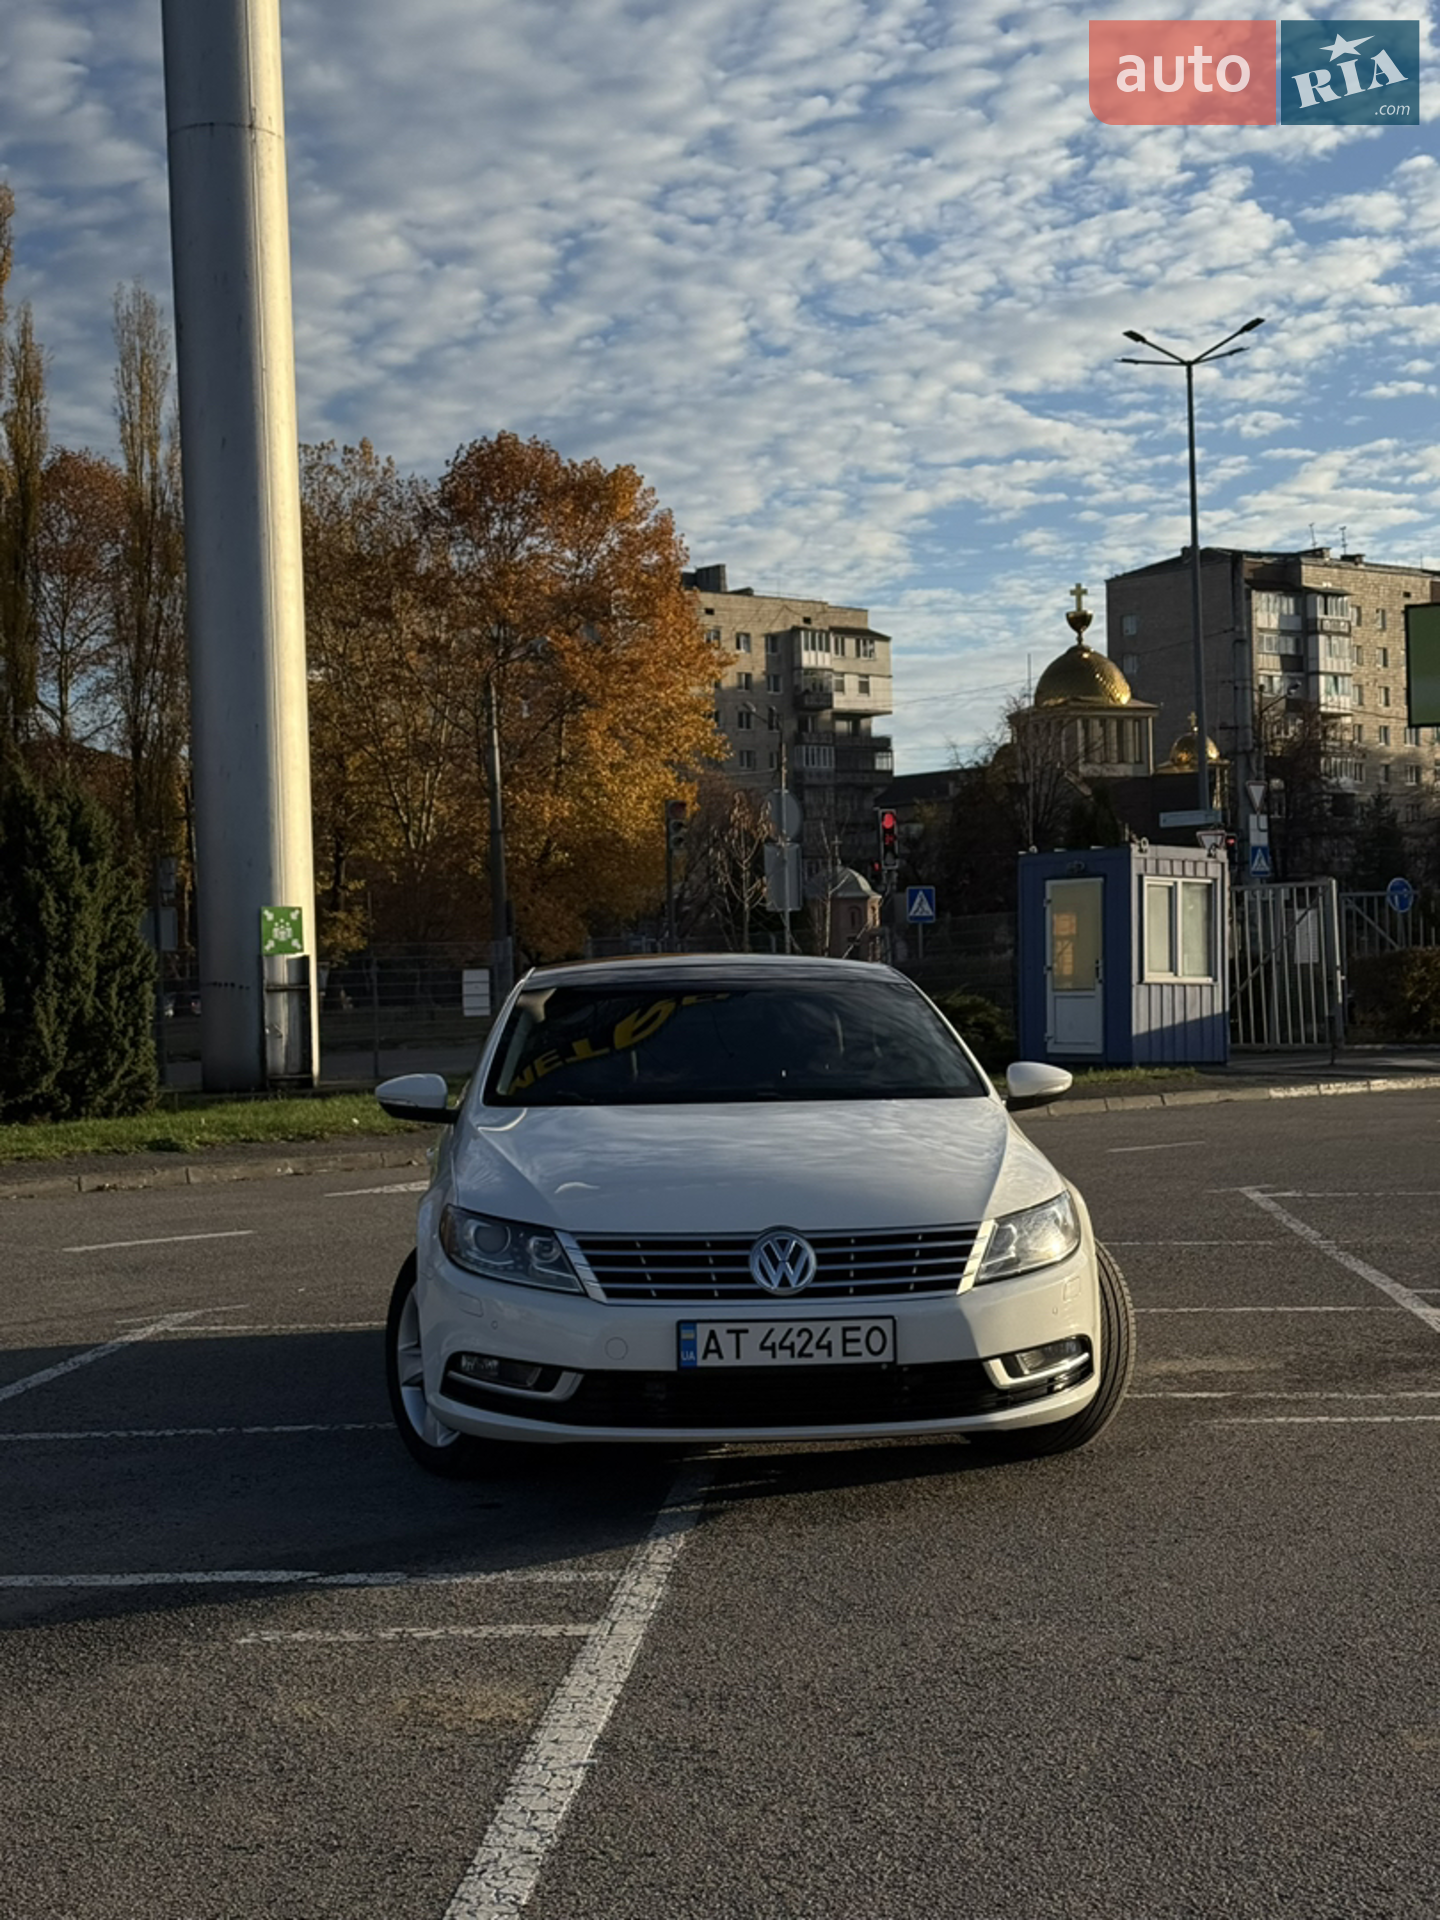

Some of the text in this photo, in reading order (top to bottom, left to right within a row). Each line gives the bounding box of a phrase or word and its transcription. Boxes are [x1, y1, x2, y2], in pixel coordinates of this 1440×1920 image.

[755, 1231, 812, 1292] VW
[680, 1350, 696, 1361] UA
[701, 1326, 887, 1360] AT 4424 EO
